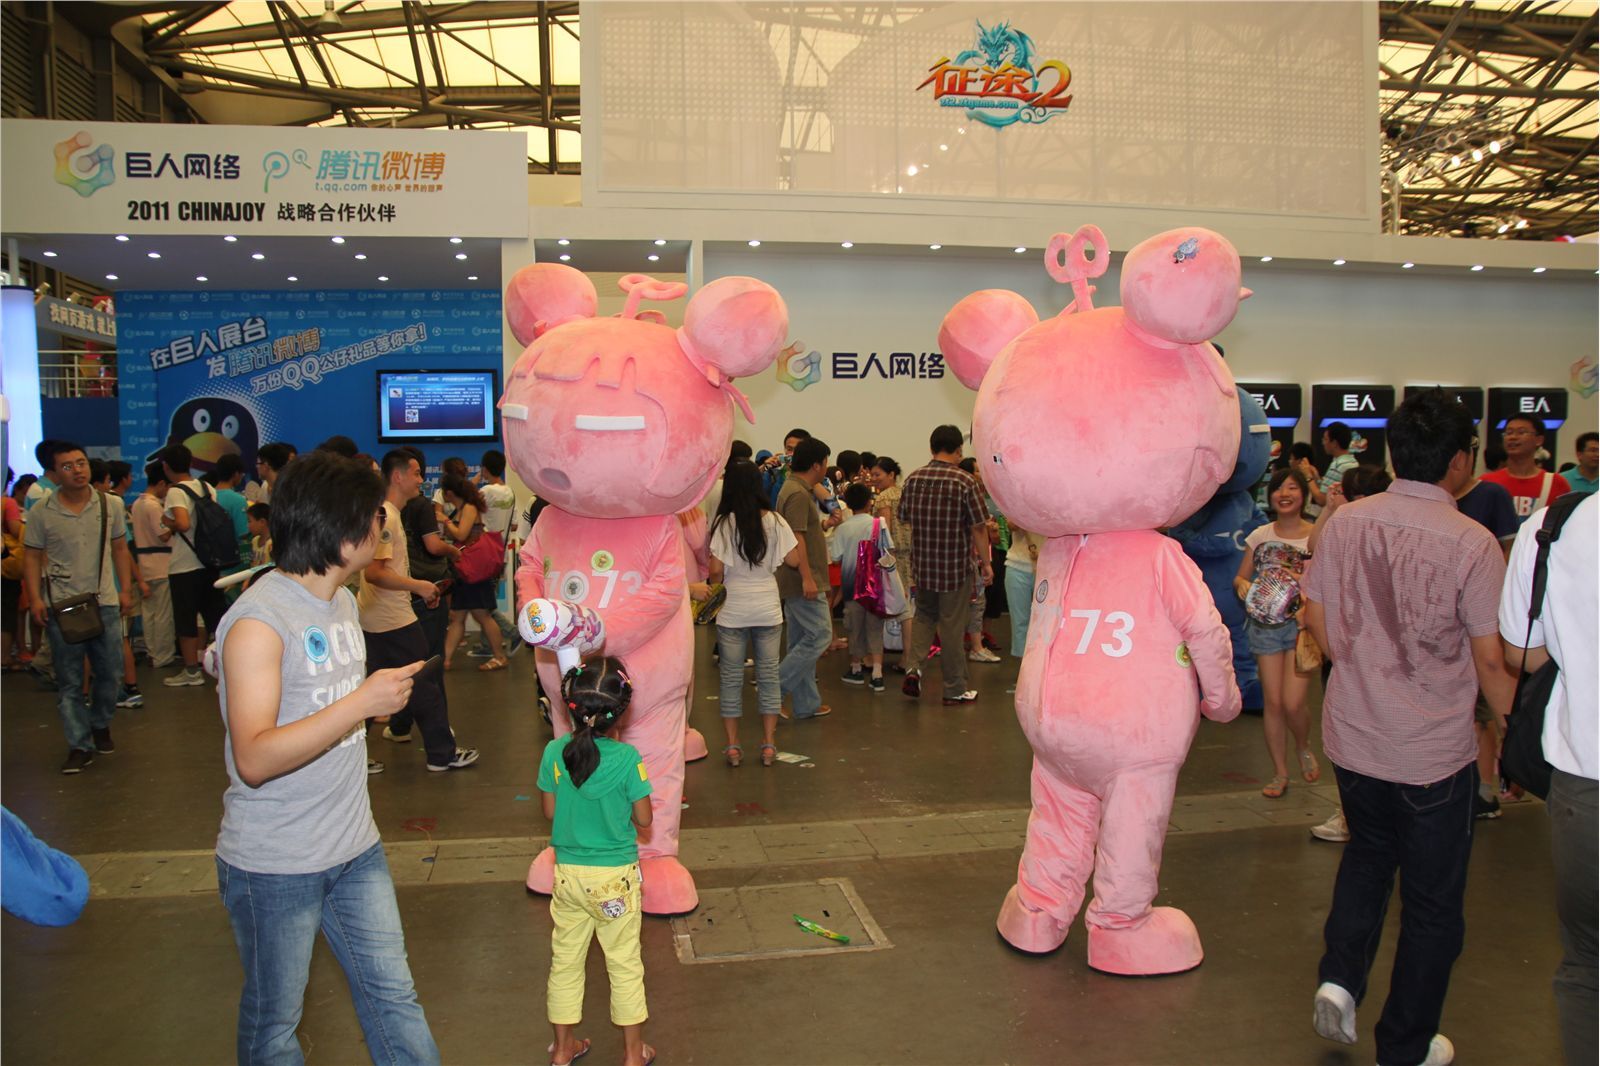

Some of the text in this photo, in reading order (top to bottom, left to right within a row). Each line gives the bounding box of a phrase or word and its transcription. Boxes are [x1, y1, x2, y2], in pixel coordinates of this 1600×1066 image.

[125, 152, 240, 179] 巨人网络
[316, 150, 446, 180] 腾讯微博
[315, 182, 368, 192] t.qq.com
[127, 201, 396, 222] 2011 CHINAJOY 战略合作伙伴
[150, 317, 268, 370] 在巨人展台
[832, 352, 945, 379] 巨人网络
[1343, 394, 1376, 412] 巨人
[1519, 396, 1550, 413] 巨人
